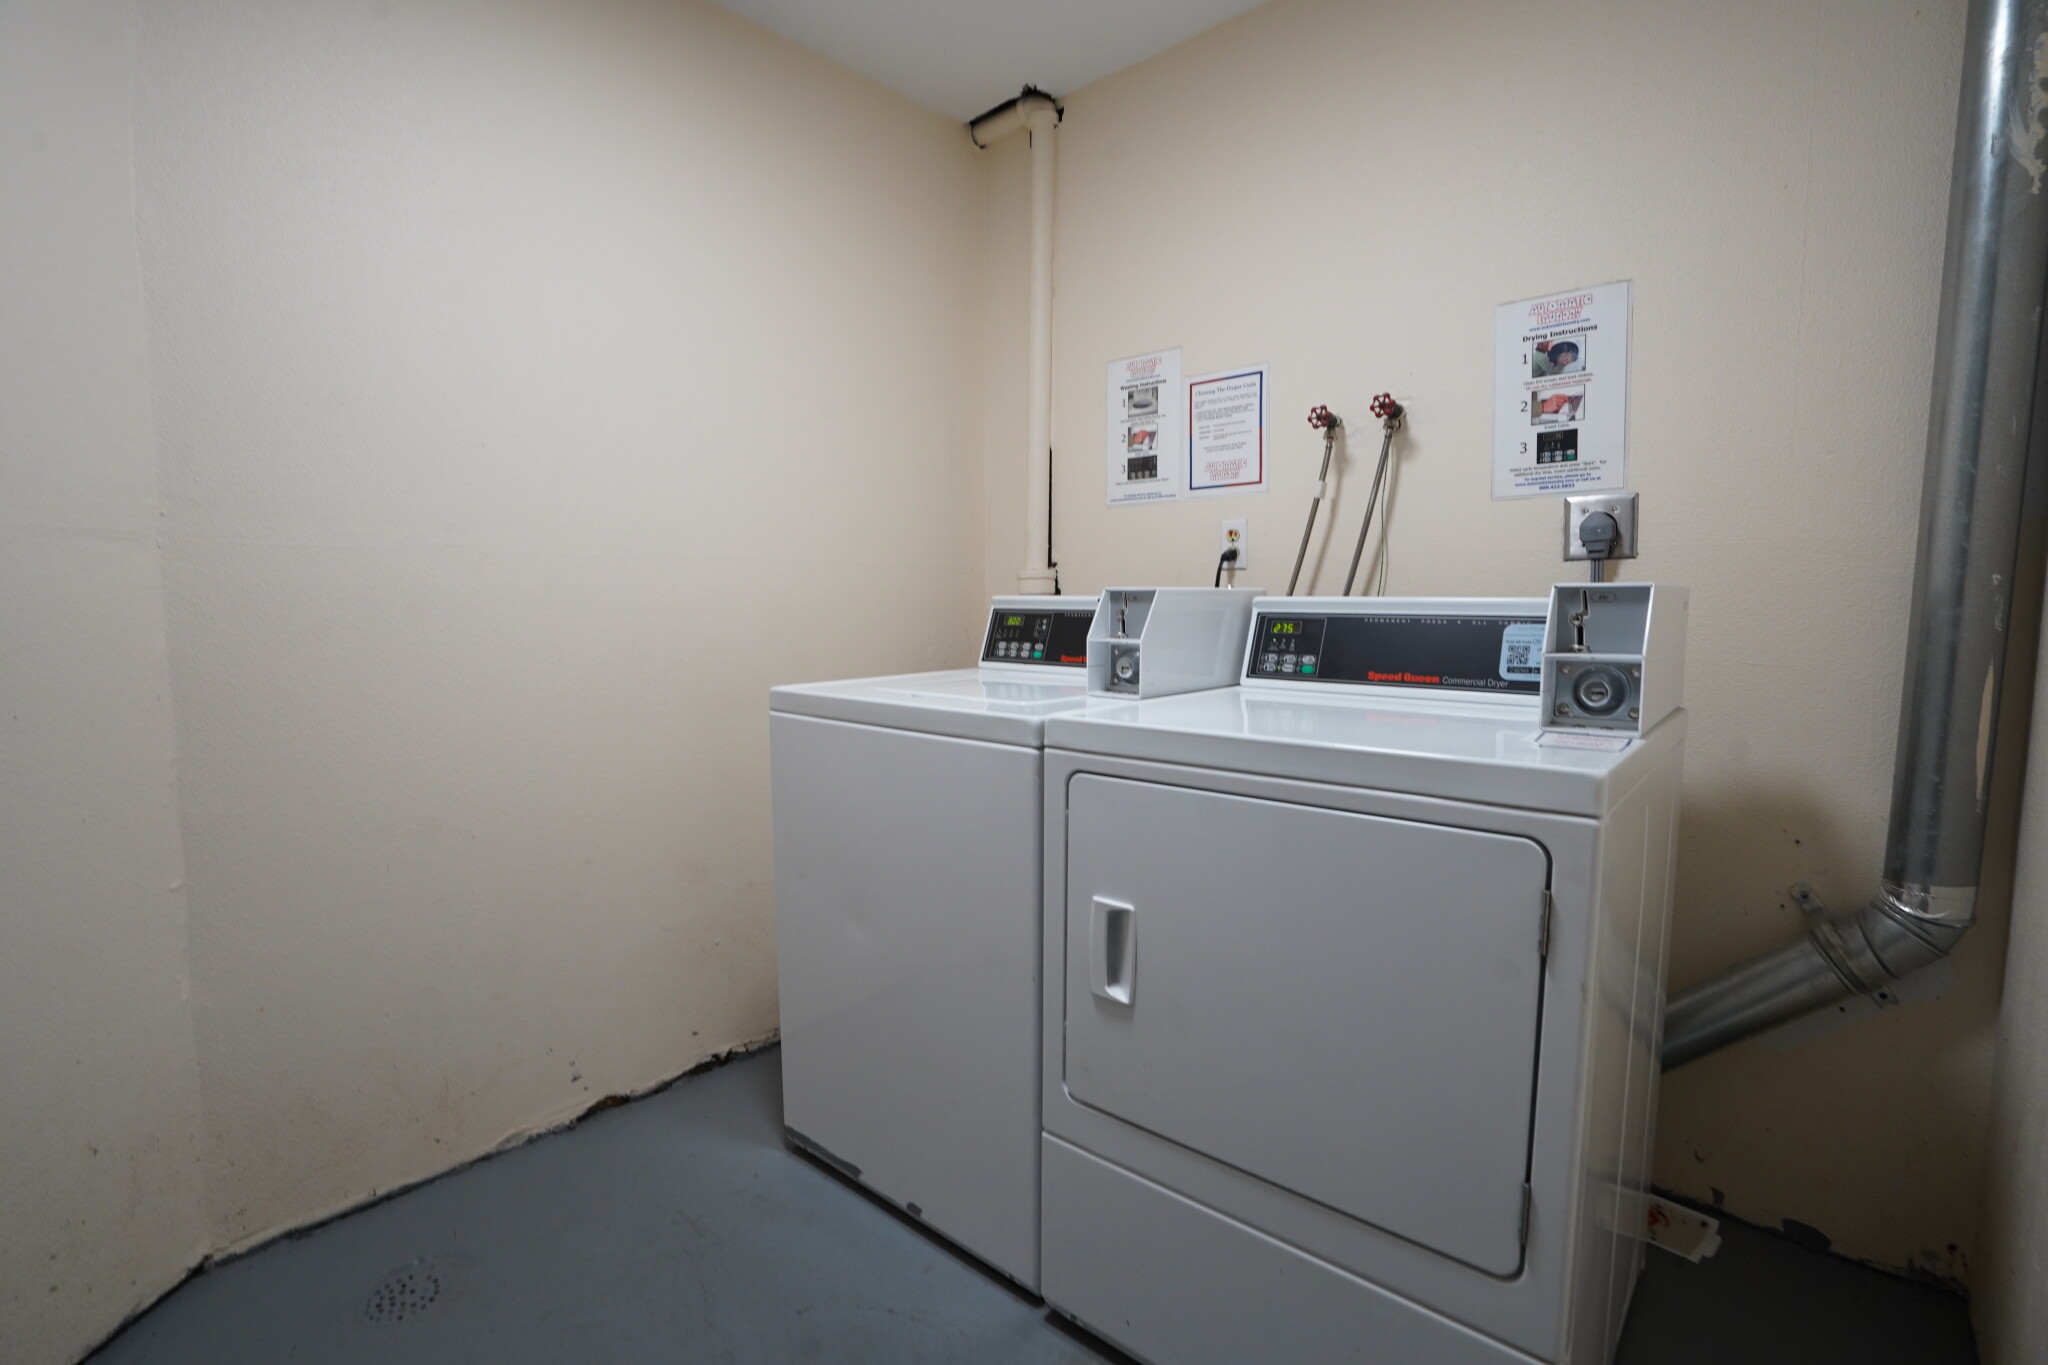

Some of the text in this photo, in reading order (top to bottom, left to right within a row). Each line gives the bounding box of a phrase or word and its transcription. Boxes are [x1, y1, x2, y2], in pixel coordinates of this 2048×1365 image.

[1529, 294, 1593, 316] AUTOMATIC
[1537, 307, 1584, 325] LAUNDRY
[1522, 325, 1598, 342] Drying Instructions
[1522, 354, 1528, 364] 1
[1520, 401, 1528, 412] 2
[1520, 442, 1528, 454] 3
[1273, 623, 1294, 634] 275
[1367, 671, 1509, 688] Speed Queen Commercial Dryer
